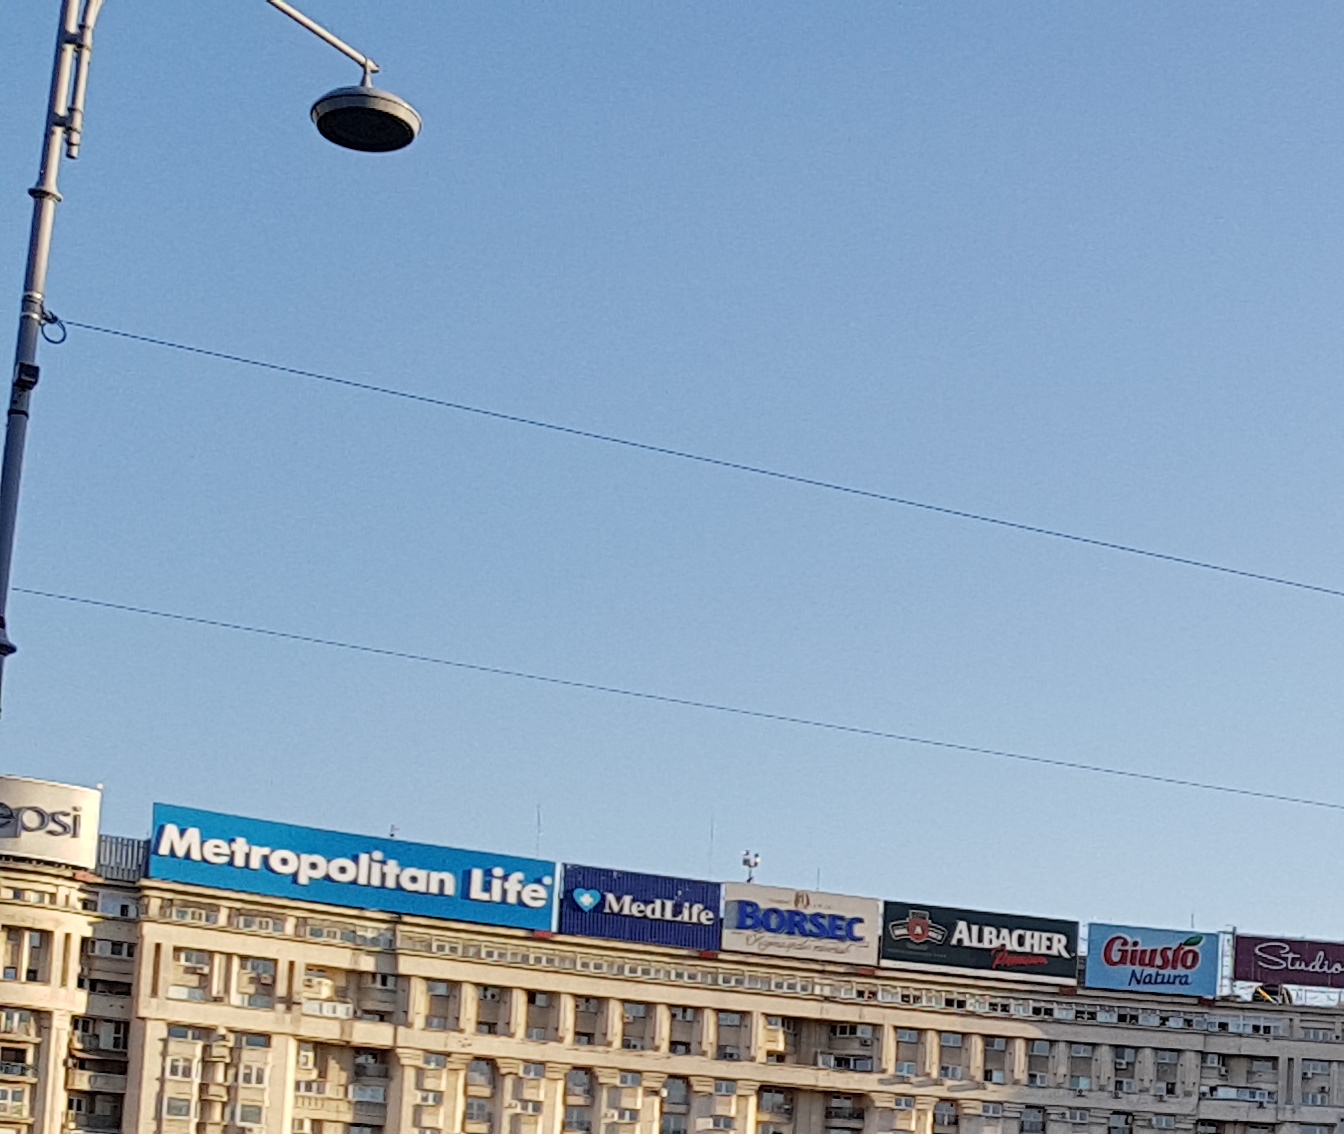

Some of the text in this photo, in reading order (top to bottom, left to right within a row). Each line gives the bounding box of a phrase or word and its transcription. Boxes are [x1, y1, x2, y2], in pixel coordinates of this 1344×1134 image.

[159, 824, 549, 909] Metropolitan Life
[603, 891, 715, 926] MedLife
[736, 900, 865, 942] BORSEC
[951, 920, 1071, 958] ALBACHER
[1104, 935, 1200, 971] Giusto
[1129, 969, 1192, 986] Natura
